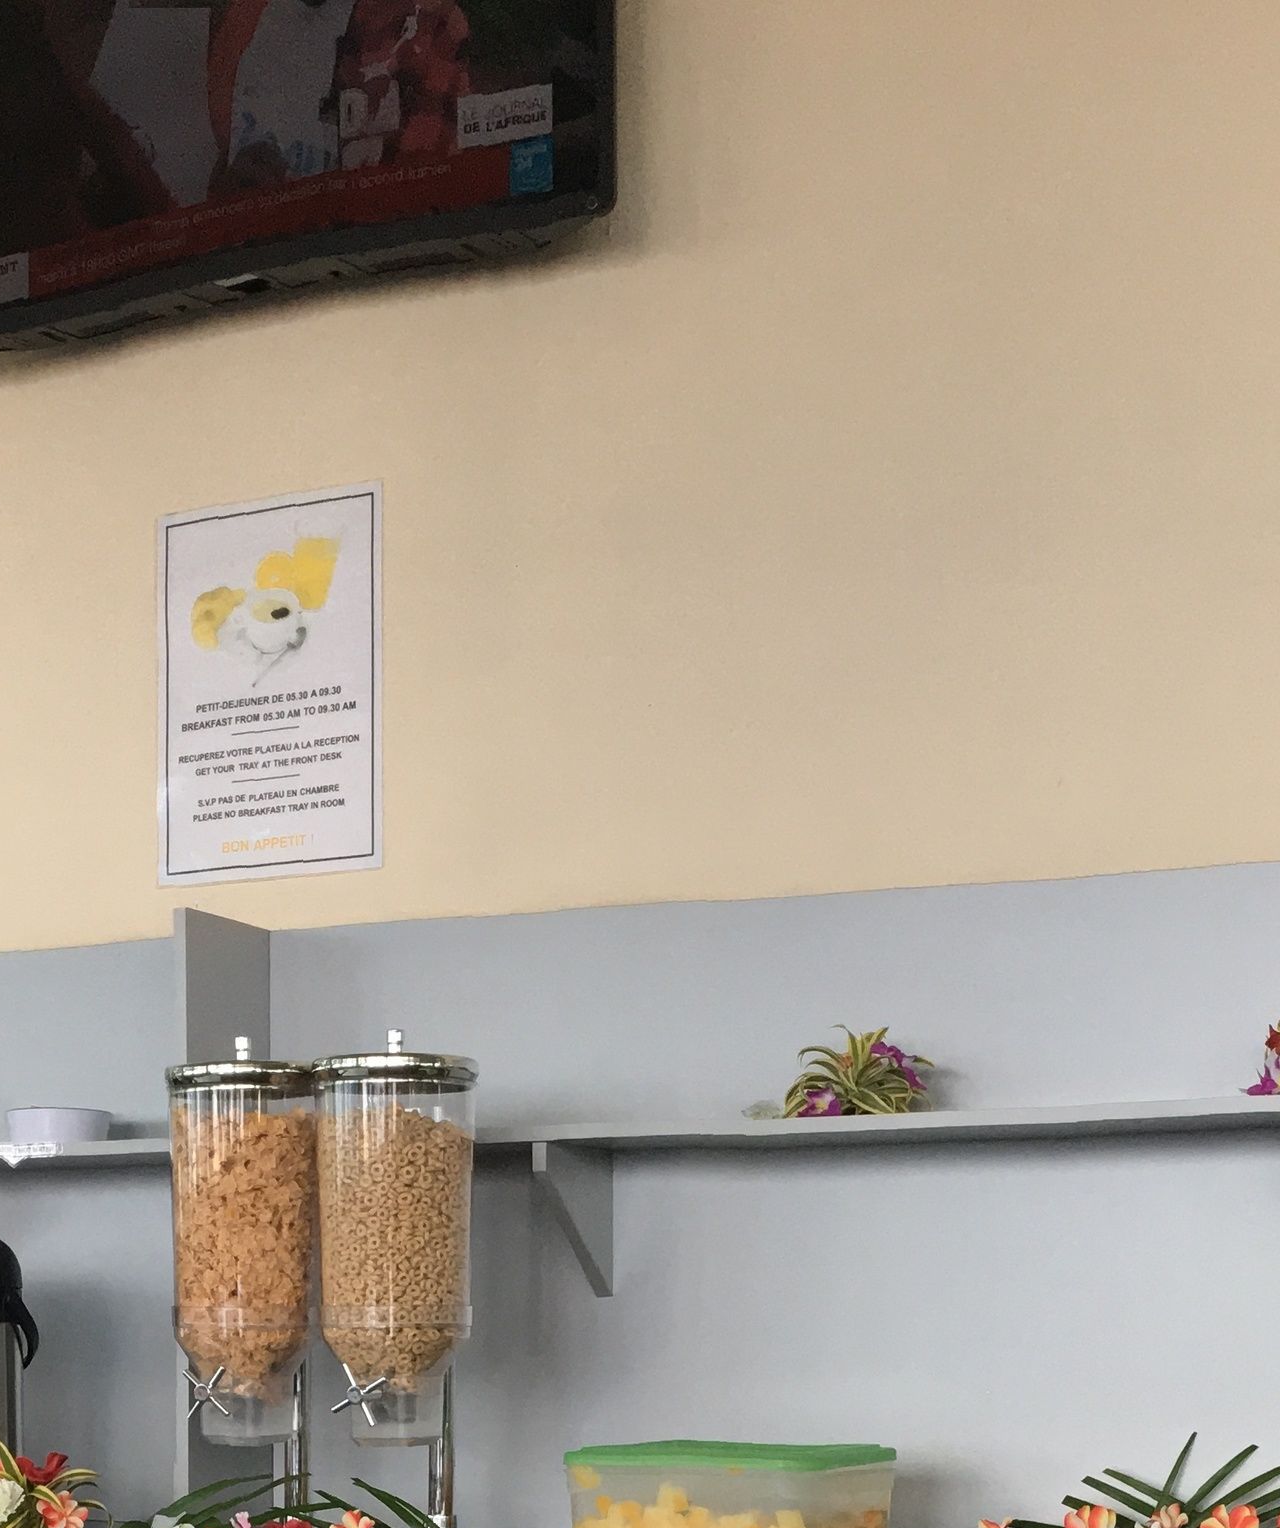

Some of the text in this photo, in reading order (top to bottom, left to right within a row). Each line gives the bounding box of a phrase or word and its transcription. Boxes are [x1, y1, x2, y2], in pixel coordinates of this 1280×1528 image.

[464, 122, 480, 134] DE
[196, 685, 341, 713] PETIT-DEJEUNER DE 05.30 A 09.30
[181, 701, 356, 732] BREAKFAST FROM 05.30 AM TO 09.30 AM
[178, 734, 360, 764] RECUPEREZ VOTRE PLATEAU A LA RECEPTION
[195, 751, 342, 777] GET YOUR TRAY AT THE FRONT DESK
[218, 795, 233, 805] PAS
[235, 794, 246, 803] DE
[248, 790, 285, 802] PLATEAU
[287, 789, 298, 798] EN
[300, 784, 340, 796] CHAMBRE
[193, 798, 345, 823] PLEASE NO BREAKFAST TRAY IN ROOM
[222, 840, 249, 854] BON
[253, 834, 307, 850] APPETIT
